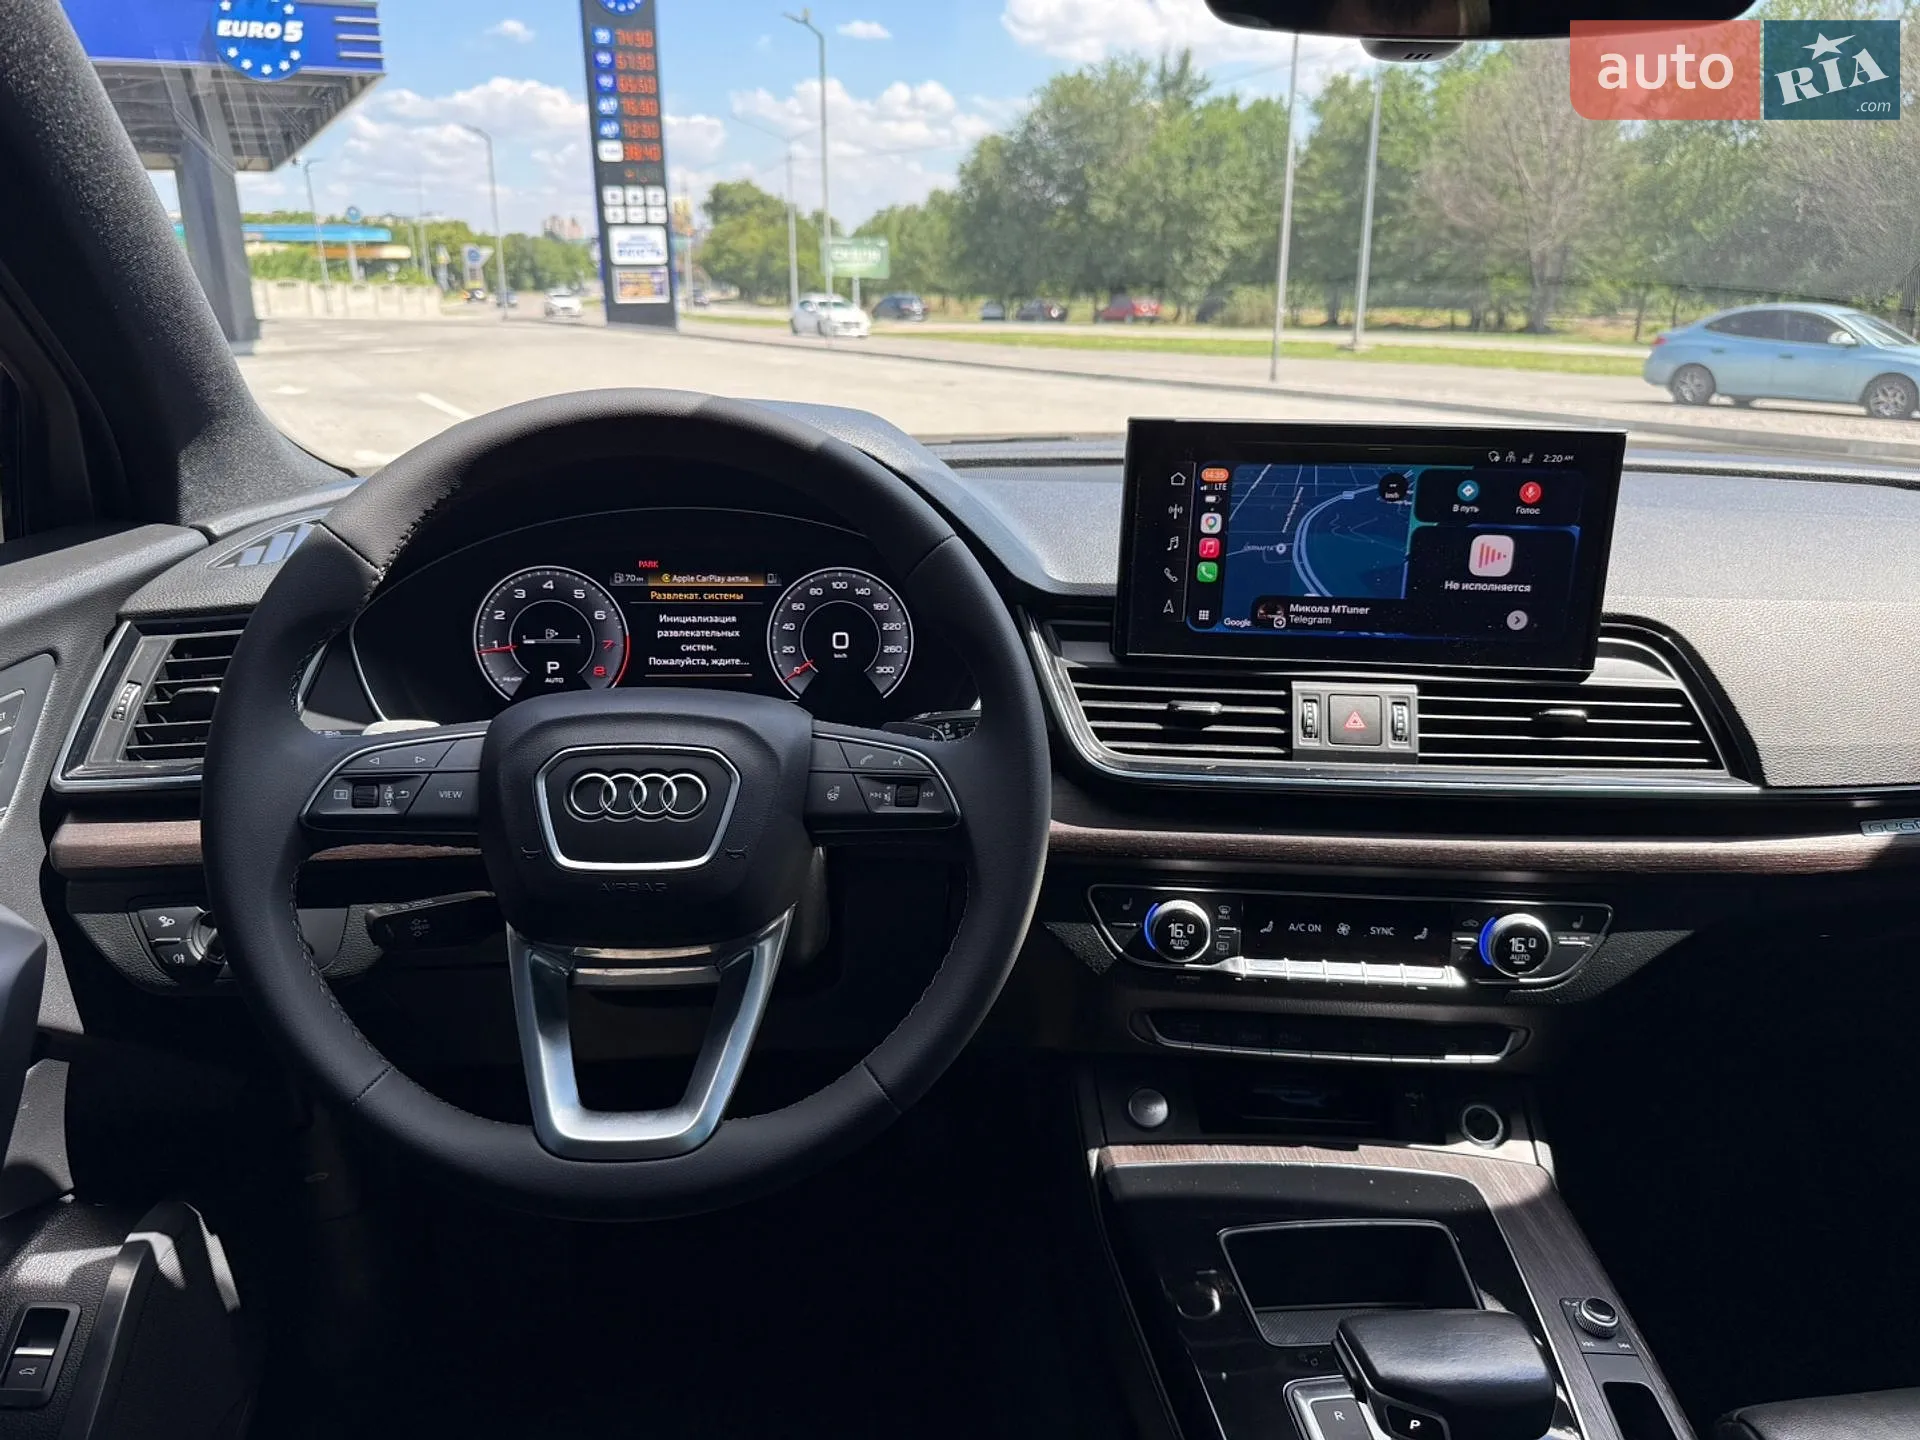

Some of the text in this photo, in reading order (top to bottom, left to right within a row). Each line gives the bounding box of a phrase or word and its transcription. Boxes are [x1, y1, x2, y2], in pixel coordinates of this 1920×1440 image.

[217, 19, 304, 42] EURO 5
[1543, 454, 1563, 463] 2:20
[1214, 483, 1227, 491] LTE
[1452, 504, 1480, 514] В путь
[1516, 506, 1541, 515] Голос
[625, 574, 636, 582] 70
[672, 574, 695, 584] Apple
[696, 574, 725, 584] CarPlay
[542, 580, 554, 590] 4
[831, 581, 848, 590] 100
[1444, 581, 1531, 592] Не исполняется
[514, 589, 526, 599] 3
[573, 589, 586, 599] 5
[650, 591, 744, 600] Развлекат. системы
[855, 588, 871, 596] 140
[791, 603, 805, 611] 60
[1289, 604, 1371, 614] Микола MTuner
[494, 610, 506, 620] 2
[594, 610, 606, 620] 6
[659, 614, 737, 624] Инициализация
[1289, 615, 1332, 625] Telegram
[782, 623, 795, 631] 40
[882, 623, 901, 631] 220
[1223, 617, 1252, 628] Google
[657, 630, 740, 639] развлекательных
[602, 640, 616, 649] 7
[832, 632, 849, 649] 0
[546, 661, 560, 674] P
[649, 657, 750, 668] Пожалуйста, ждите...
[593, 666, 607, 676] 8
[875, 666, 895, 674] 300
[439, 790, 464, 798] VIEW
[1288, 922, 1322, 932] A/C ON
[1369, 926, 1395, 936] SYNC
[1333, 1410, 1346, 1421] R
[1409, 1419, 1421, 1430] P
